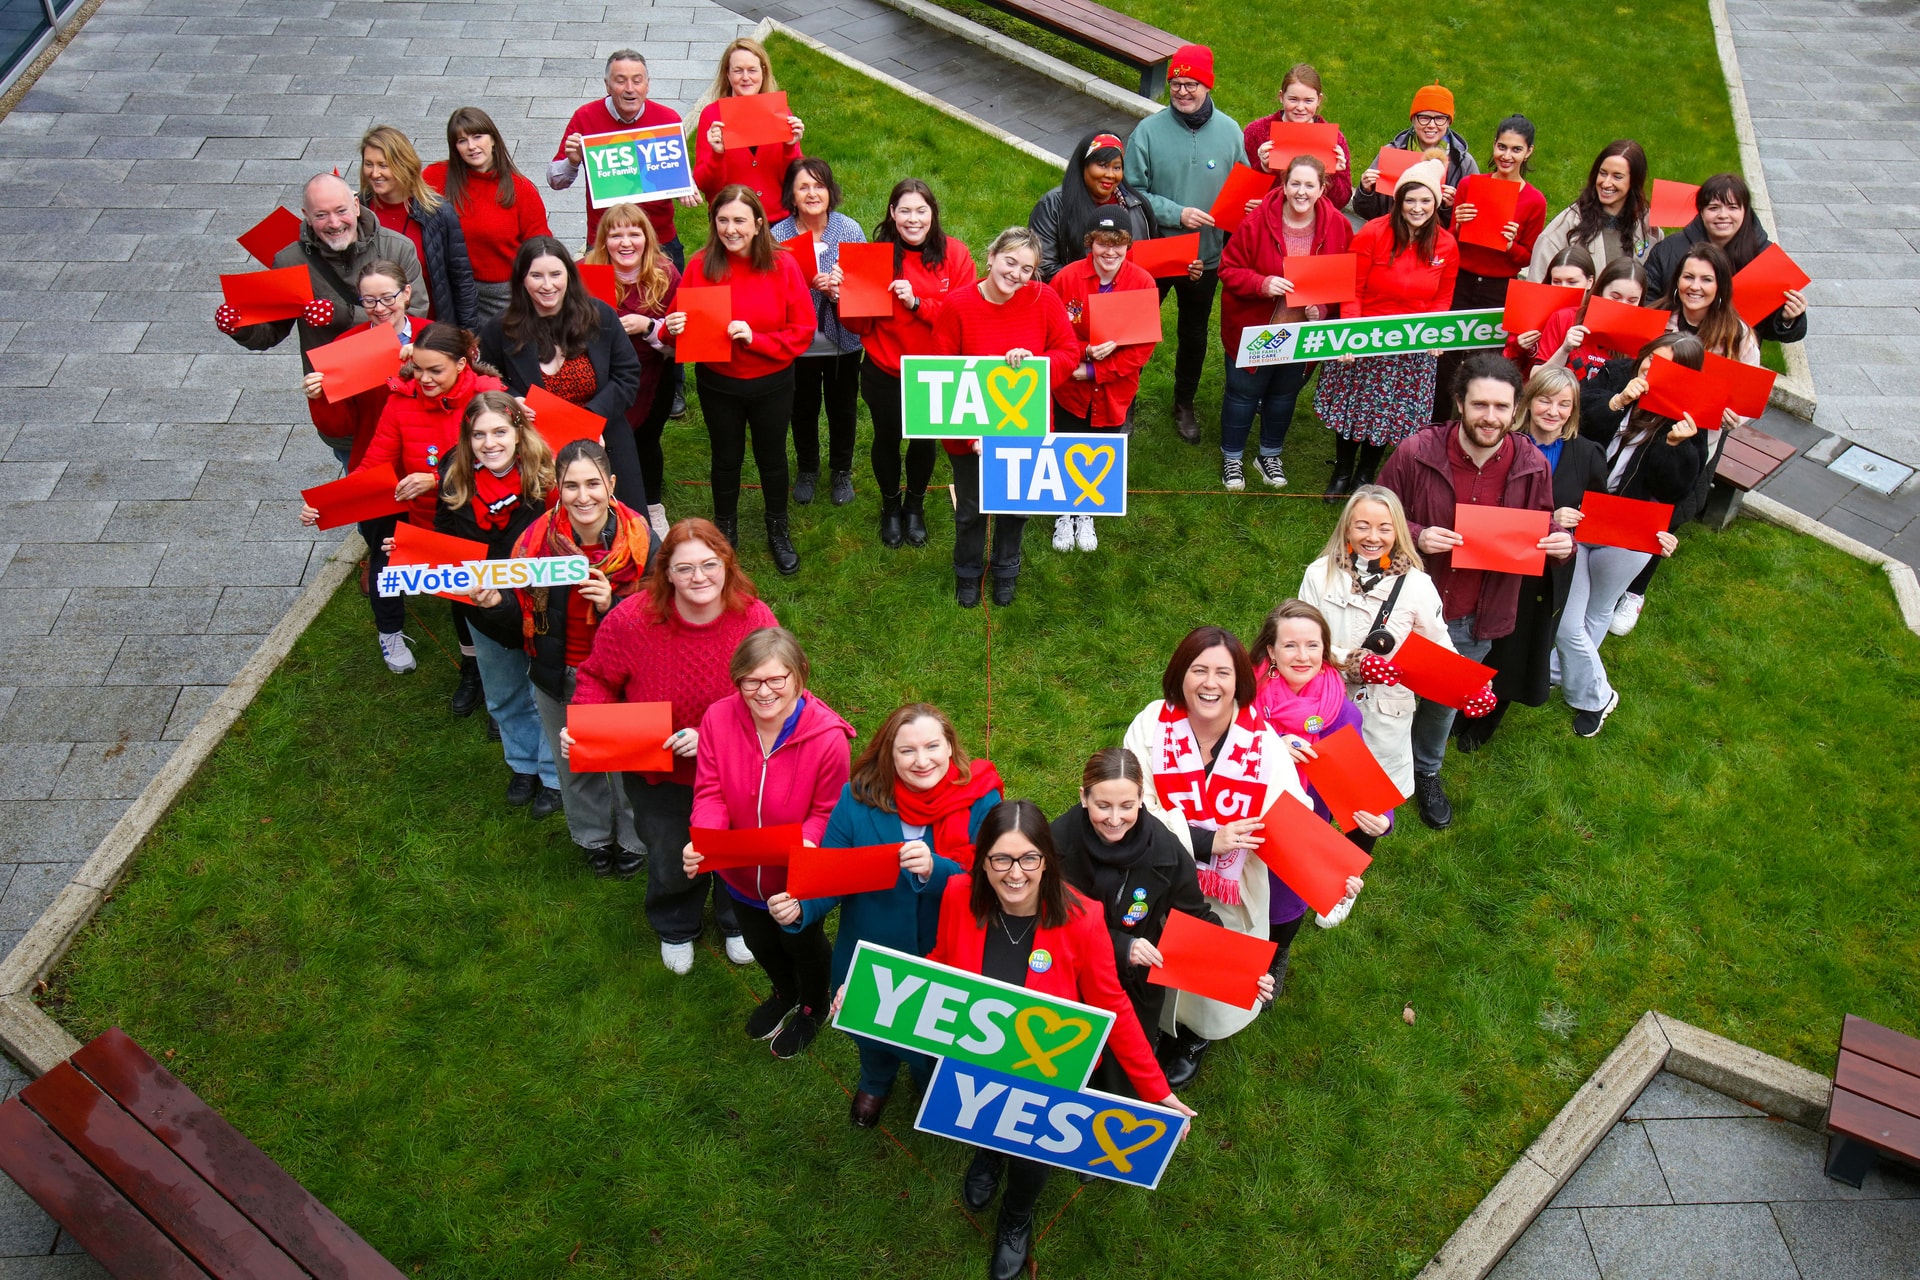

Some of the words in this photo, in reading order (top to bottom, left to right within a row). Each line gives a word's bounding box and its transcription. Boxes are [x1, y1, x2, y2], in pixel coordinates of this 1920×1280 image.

[589, 146, 635, 171] YES
[637, 140, 682, 164] YES
[597, 170, 611, 178] For
[611, 166, 638, 176] Family
[647, 163, 660, 171] For
[660, 161, 680, 169] Care
[1248, 337, 1266, 351] YES
[1265, 335, 1284, 350] YES
[1302, 319, 1510, 354] #VoteYesYes
[917, 359, 990, 425] TÁ
[995, 436, 1068, 501] TÁ
[382, 559, 586, 593] #VoteYESYES
[1215, 788, 1253, 818] 5
[1032, 960, 1044, 969] YES
[1034, 953, 1045, 961] YES
[872, 964, 1017, 1055] YES
[954, 1071, 1096, 1153] YES
